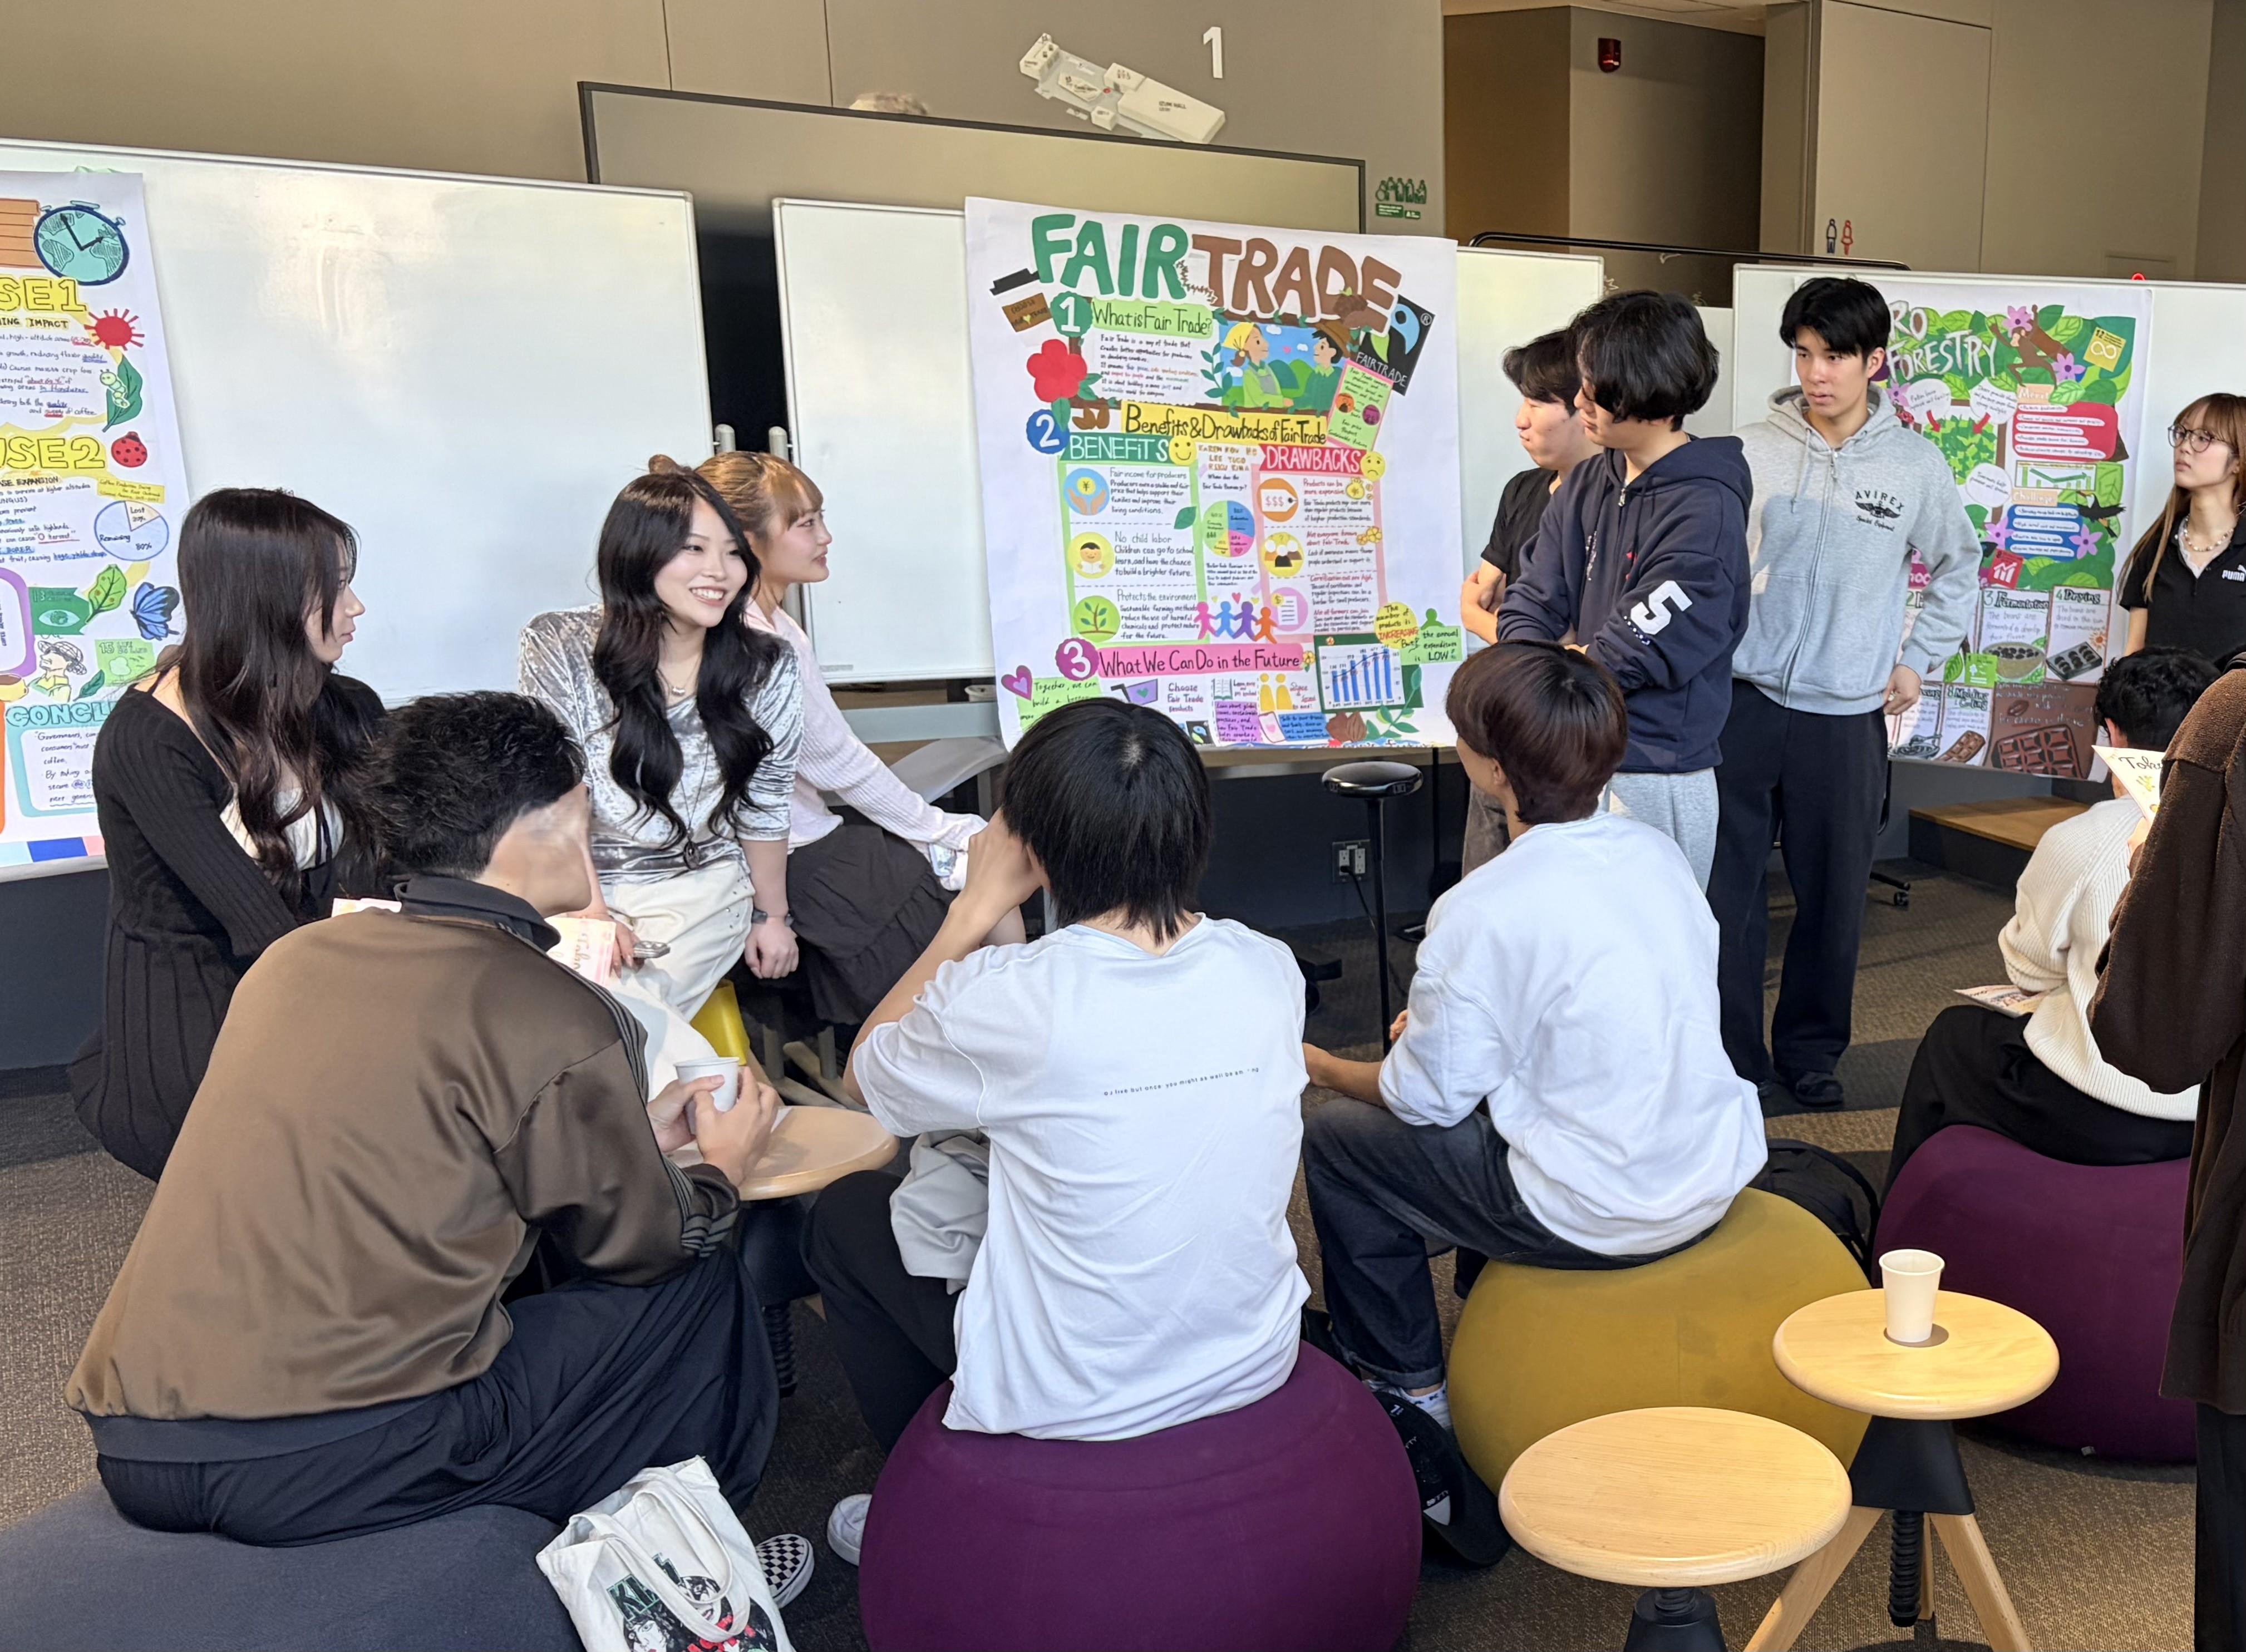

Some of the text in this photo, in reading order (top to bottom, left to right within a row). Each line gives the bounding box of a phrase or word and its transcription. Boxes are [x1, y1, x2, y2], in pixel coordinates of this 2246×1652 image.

[1203, 27, 1223, 78] 1
[1032, 214, 1402, 333] FAIR TRADE
[1060, 296, 1080, 332] 1
[1092, 302, 1212, 335] What is Fair Trade?
[29, 319, 68, 328] IMPACT
[1117, 334, 1129, 343] Trade
[2095, 329, 2105, 339] 12
[1886, 329, 1997, 383] FORESTRY
[1356, 352, 1407, 387] FAIRTRADE
[1125, 403, 1327, 445] Benefits & Drawbacks of Fair Trade
[1035, 414, 1060, 447] 2
[1266, 447, 1361, 472] DRAWBACKS
[1110, 467, 1123, 478] Fair
[1146, 468, 1156, 478] for
[1157, 471, 1187, 481] producers
[16, 476, 58, 485] EXPANSION
[1303, 478, 1325, 486] Products
[1855, 490, 1905, 512] AVIREX
[1112, 506, 1126, 515] living
[100, 534, 131, 543] Remaining
[1115, 531, 1171, 543] No child labor
[1115, 545, 1140, 554] Children
[1143, 568, 1167, 577] brighter
[2222, 570, 2245, 582] PUMA
[32, 590, 46, 602] 13
[1117, 589, 1196, 601] Protects the environment
[1905, 591, 1915, 606] 2
[1984, 590, 2049, 609] 3 Fermentation
[2056, 589, 2101, 604] 4 Drying
[1152, 605, 1174, 613] farming
[1630, 580, 1693, 635] 5
[1161, 623, 1182, 634] protect
[1379, 621, 1401, 630] products
[1378, 627, 1419, 640] INCREASING
[1436, 628, 1459, 637] annual
[99, 642, 115, 654] 15
[1063, 640, 1091, 678] 3
[1429, 650, 1449, 660] LOW
[1099, 649, 1300, 678] What We Can Do in the Future
[1034, 682, 1070, 693] Together,
[1168, 683, 1198, 693] Choose
[1033, 697, 1050, 707] build
[1168, 694, 1204, 703] Fair Trade
[46, 770, 56, 779] By
